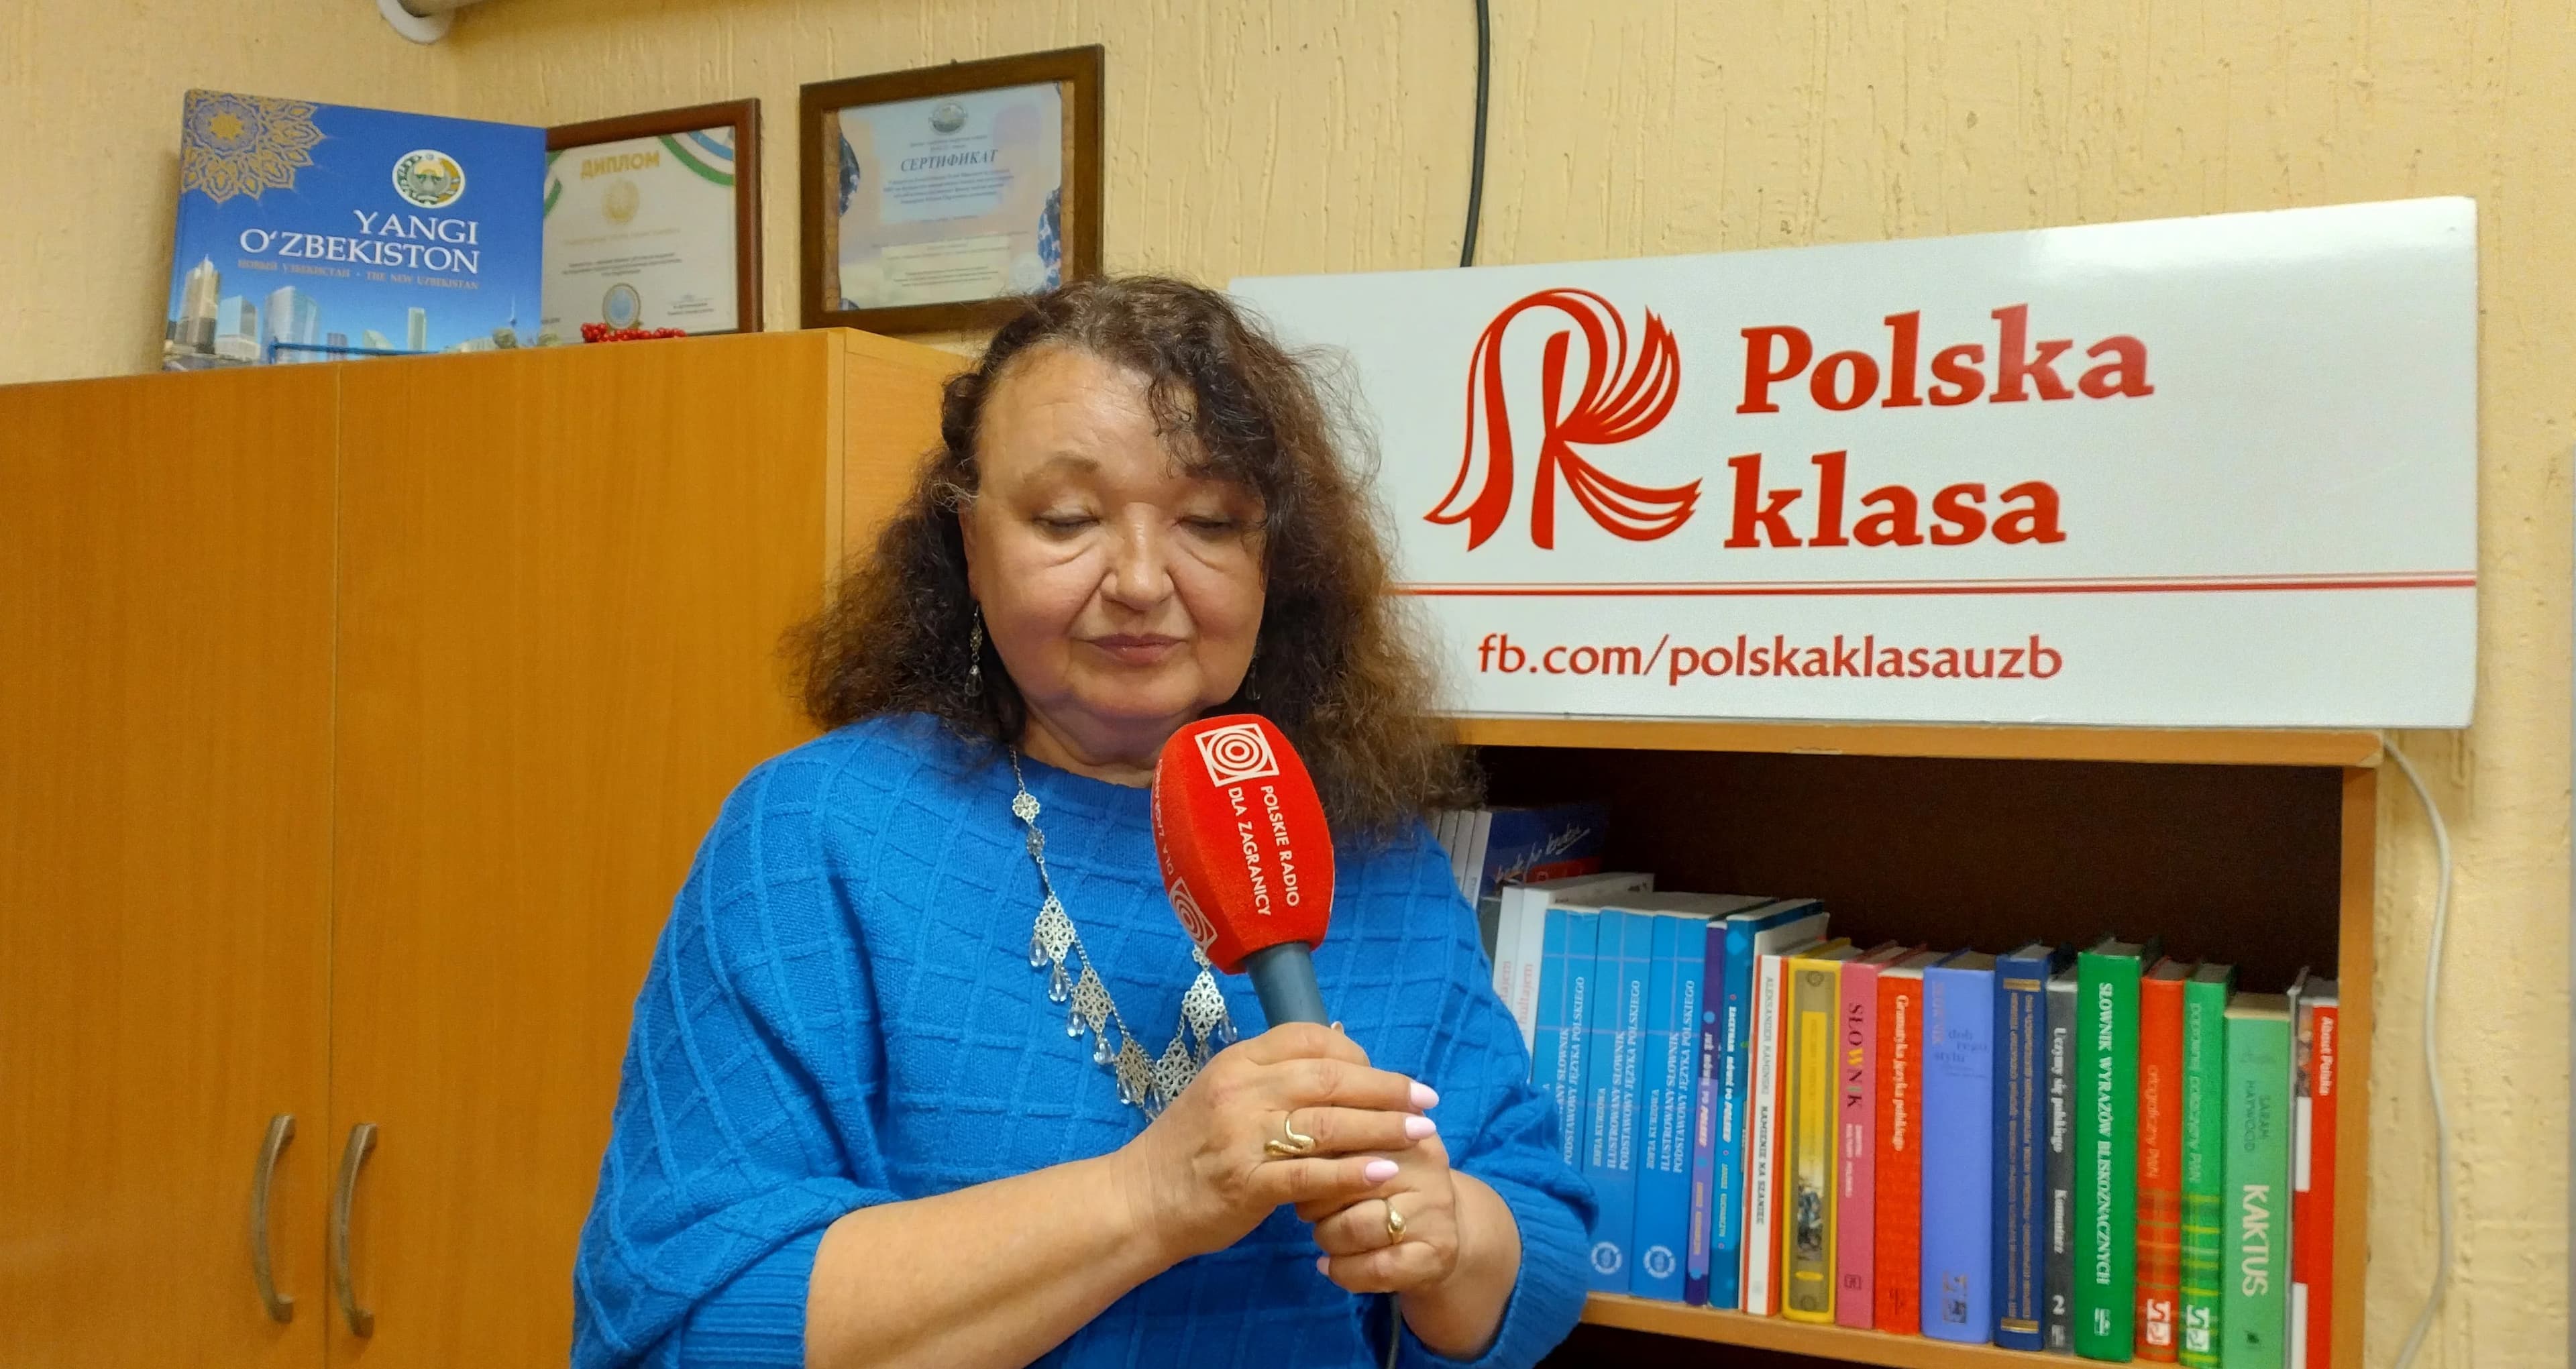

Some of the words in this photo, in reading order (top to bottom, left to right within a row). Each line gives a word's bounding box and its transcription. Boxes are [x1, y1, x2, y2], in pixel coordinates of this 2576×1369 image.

[580, 151, 660, 181] ДИПЛОМ
[900, 148, 999, 172] СЕРТИФИКАТ
[354, 209, 479, 245] YANGI
[366, 271, 387, 282] THE
[390, 273, 413, 284] NEW
[417, 276, 479, 290] UZBEKISTAN
[1736, 303, 2155, 415] Polska
[1723, 449, 2066, 549] klasa
[1477, 631, 2063, 686] fb.com/polskaklasauzb
[1228, 787, 1245, 817] DLA
[1237, 820, 1272, 917] ZAGRANICY
[1260, 785, 1290, 847] POLSKIE
[1279, 851, 1299, 907] RADIO
[1572, 977, 1585, 1042] POLSKIEGO
[1627, 980, 1640, 1045] POLSKIEGO
[1681, 980, 1695, 1046] POLSKIEGO
[2098, 983, 2113, 1051] SŁOWNIK
[1556, 1028, 1568, 1081] SŁOWNIK
[1569, 1044, 1581, 1085] JĘZYKA
[1613, 1031, 1625, 1085] SŁOWNIK
[1625, 1048, 1637, 1089] JĘZYKA
[1666, 1032, 1678, 1087] SŁOWNIK
[1678, 1050, 1690, 1091] JĘZYKA
[1847, 1003, 1864, 1108] SŁOWNIK
[1564, 1087, 1577, 1164] PODSTAWOWY
[1607, 1087, 1621, 1168] ILUSTROWANY
[1660, 1088, 1674, 1171] ILUSTROWANY
[2097, 1056, 2113, 1138] WYRAZÓW
[2244, 1080, 2256, 1151] HAYWOOD
[2258, 1095, 2271, 1139] SARAH
[1619, 1091, 1633, 1170] PODSTAWOWY
[1673, 1093, 1687, 1173] PODSTAWOWY
[1758, 1105, 1769, 1158] KAMIENIE
[1758, 1162, 1766, 1176] NA
[2096, 1140, 2112, 1285] BLISKOZNACZNYCH
[2242, 1185, 2270, 1297] KAKTUS
[2052, 1295, 2065, 1315] 2
